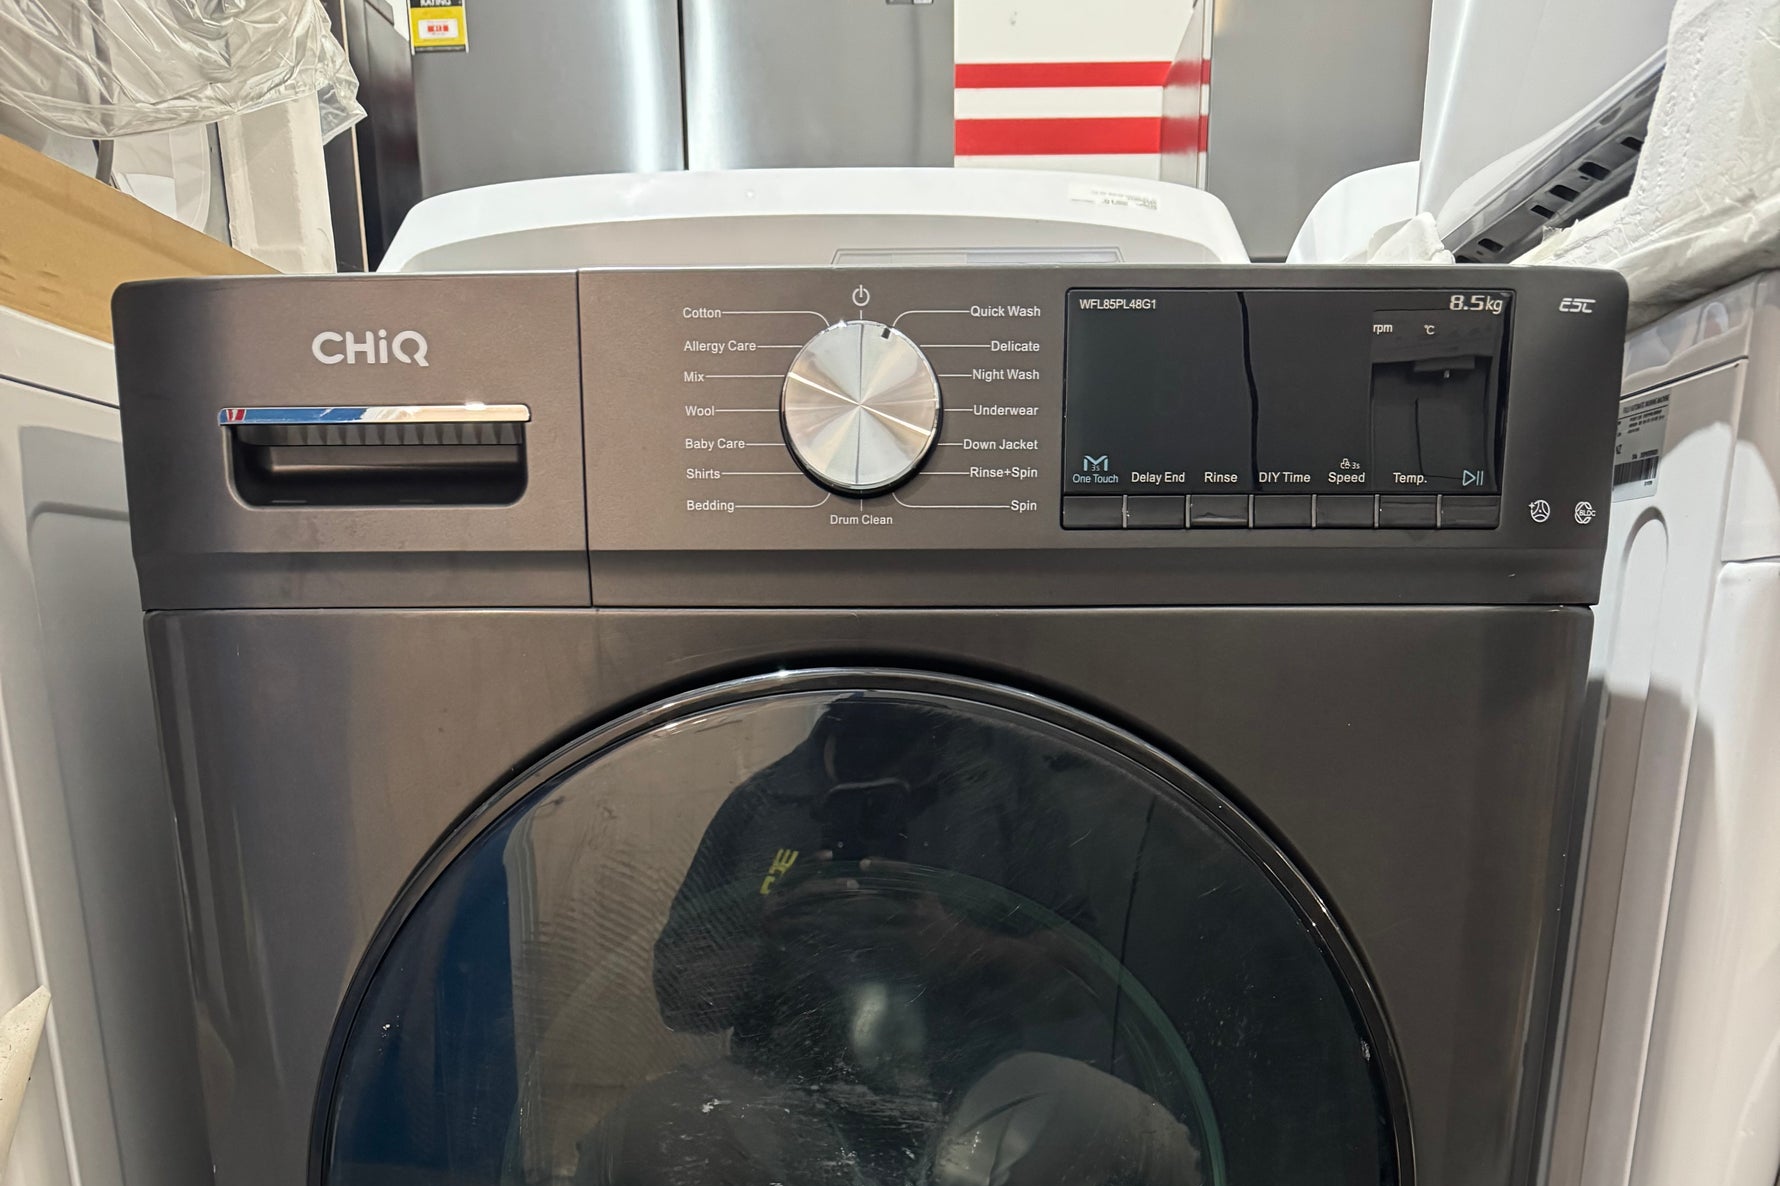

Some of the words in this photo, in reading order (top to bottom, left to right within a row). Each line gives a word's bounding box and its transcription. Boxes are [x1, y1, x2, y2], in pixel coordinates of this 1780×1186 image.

[1080, 299, 1156, 309] WFL85PL48G1
[1450, 295, 1502, 314] 8.5kg
[683, 307, 721, 319] Cotton
[970, 306, 1005, 318] Quick
[1008, 306, 1041, 317] Wash
[1373, 324, 1392, 334] rpm
[312, 329, 429, 367] CHiQ
[684, 341, 727, 353] Allergy
[730, 341, 756, 351] Care
[991, 341, 1040, 352] Delicate
[684, 372, 704, 382] Mix
[972, 369, 1006, 382] Night
[1008, 370, 1039, 380] Wash
[685, 405, 715, 416] Wool
[973, 405, 1038, 416] Underwear
[685, 439, 713, 450] Baby
[717, 439, 745, 448] Care
[963, 439, 997, 449] Down
[1001, 439, 1038, 450] Jacket
[686, 469, 721, 479] Shirts
[970, 467, 1038, 479] Rinse+Spin
[1073, 474, 1090, 483] One
[1093, 474, 1118, 483] Touch
[1132, 472, 1162, 484] Delay
[1165, 472, 1185, 482] End
[1205, 472, 1237, 482] Rinse
[1259, 472, 1280, 482] DIY
[1283, 472, 1311, 482] Time
[1328, 472, 1365, 485] Speed
[1393, 473, 1427, 485] Temp.
[687, 501, 735, 513] Bedding
[1011, 501, 1037, 512] Spin
[830, 515, 859, 525] Drum
[862, 515, 893, 525] Clean
